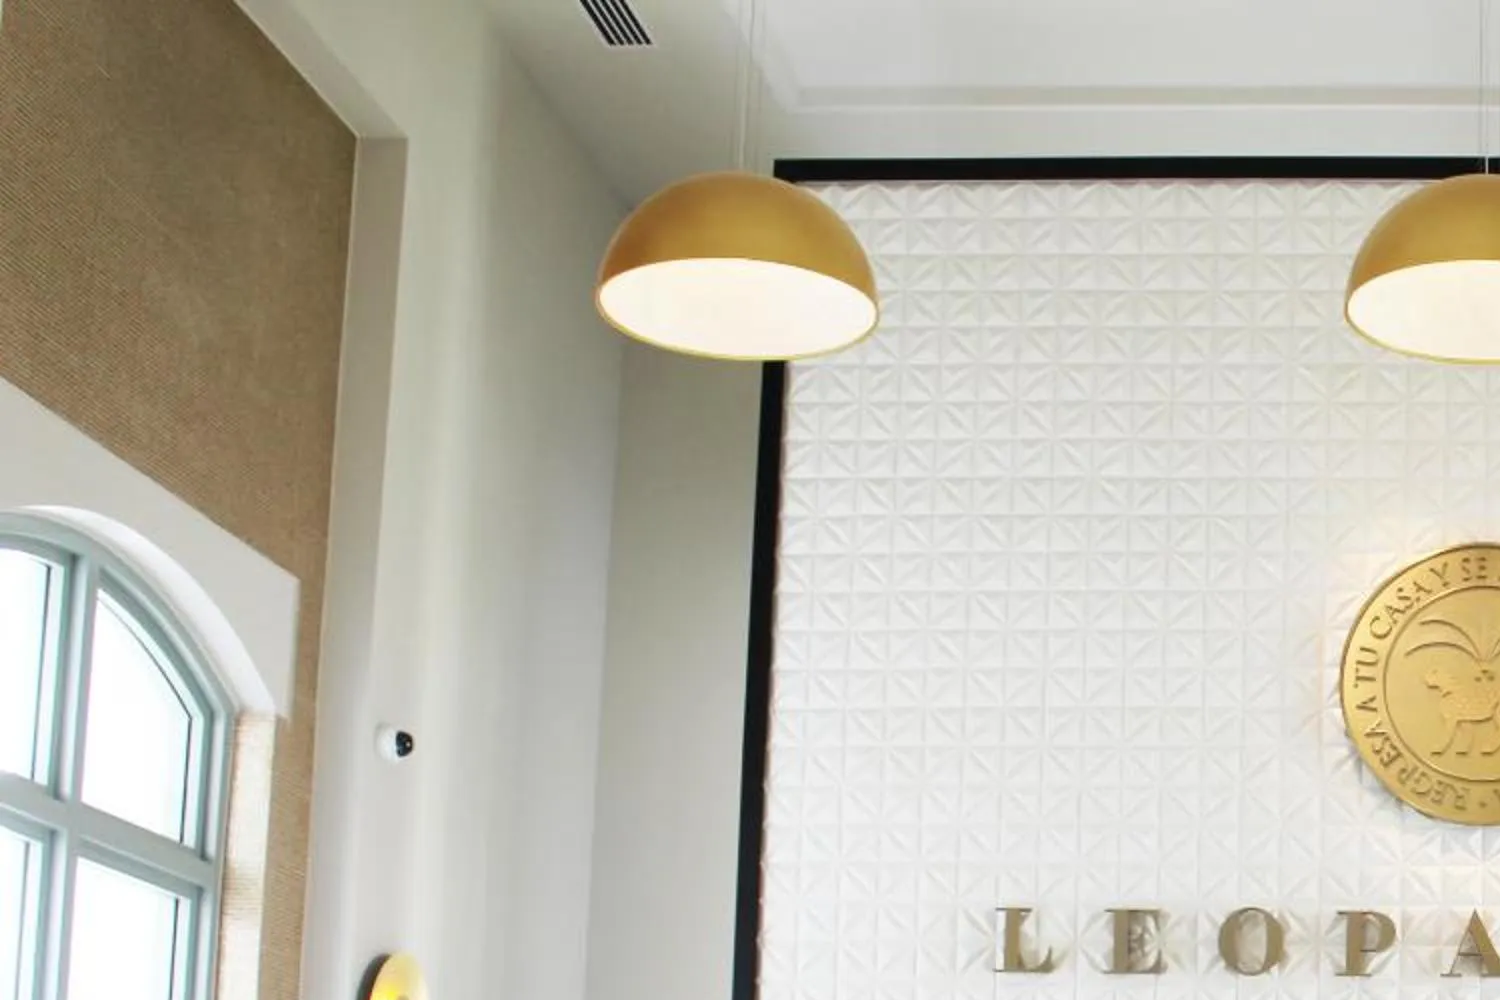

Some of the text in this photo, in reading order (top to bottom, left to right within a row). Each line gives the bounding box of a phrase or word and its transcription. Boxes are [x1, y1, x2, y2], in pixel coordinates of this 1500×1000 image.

[1428, 561, 1451, 588] Y
[1460, 556, 1489, 583] SE
[1368, 580, 1434, 640] CASA
[1352, 645, 1380, 689] TU
[1354, 694, 1379, 714] A
[1362, 717, 1472, 811] REGRESA
